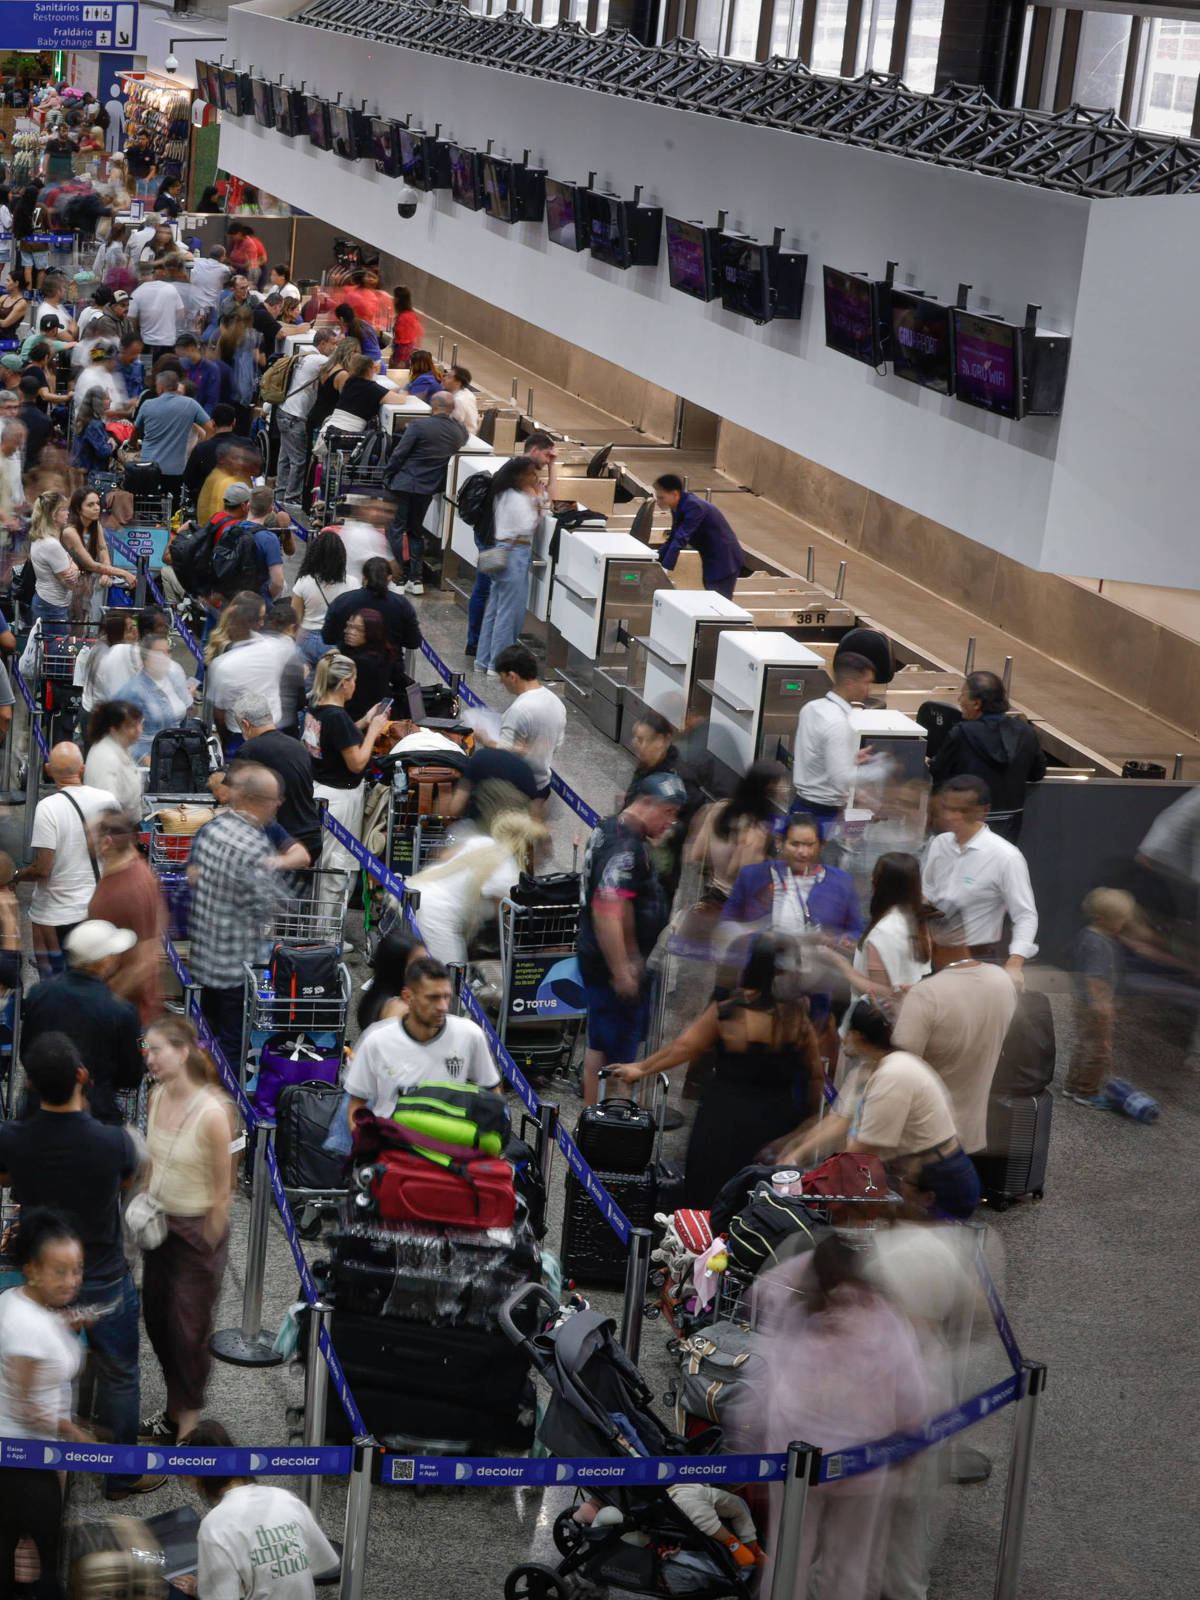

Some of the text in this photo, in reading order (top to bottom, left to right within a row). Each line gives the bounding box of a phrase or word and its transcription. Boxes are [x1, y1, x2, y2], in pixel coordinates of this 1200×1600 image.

[35, 3, 80, 12] Sanitários
[33, 13, 80, 22] Restrooms
[53, 27, 93, 37] Fraldário
[37, 37, 93, 48] Baby change
[796, 613, 826, 624] 38 R
[65, 1451, 115, 1463] decolar
[168, 1455, 217, 1467] decolar
[271, 1455, 321, 1467] decolar
[476, 1466, 525, 1477] decolar
[577, 1466, 626, 1477] decolar
[679, 1463, 728, 1475] decolar
[256, 1521, 299, 1547] three
